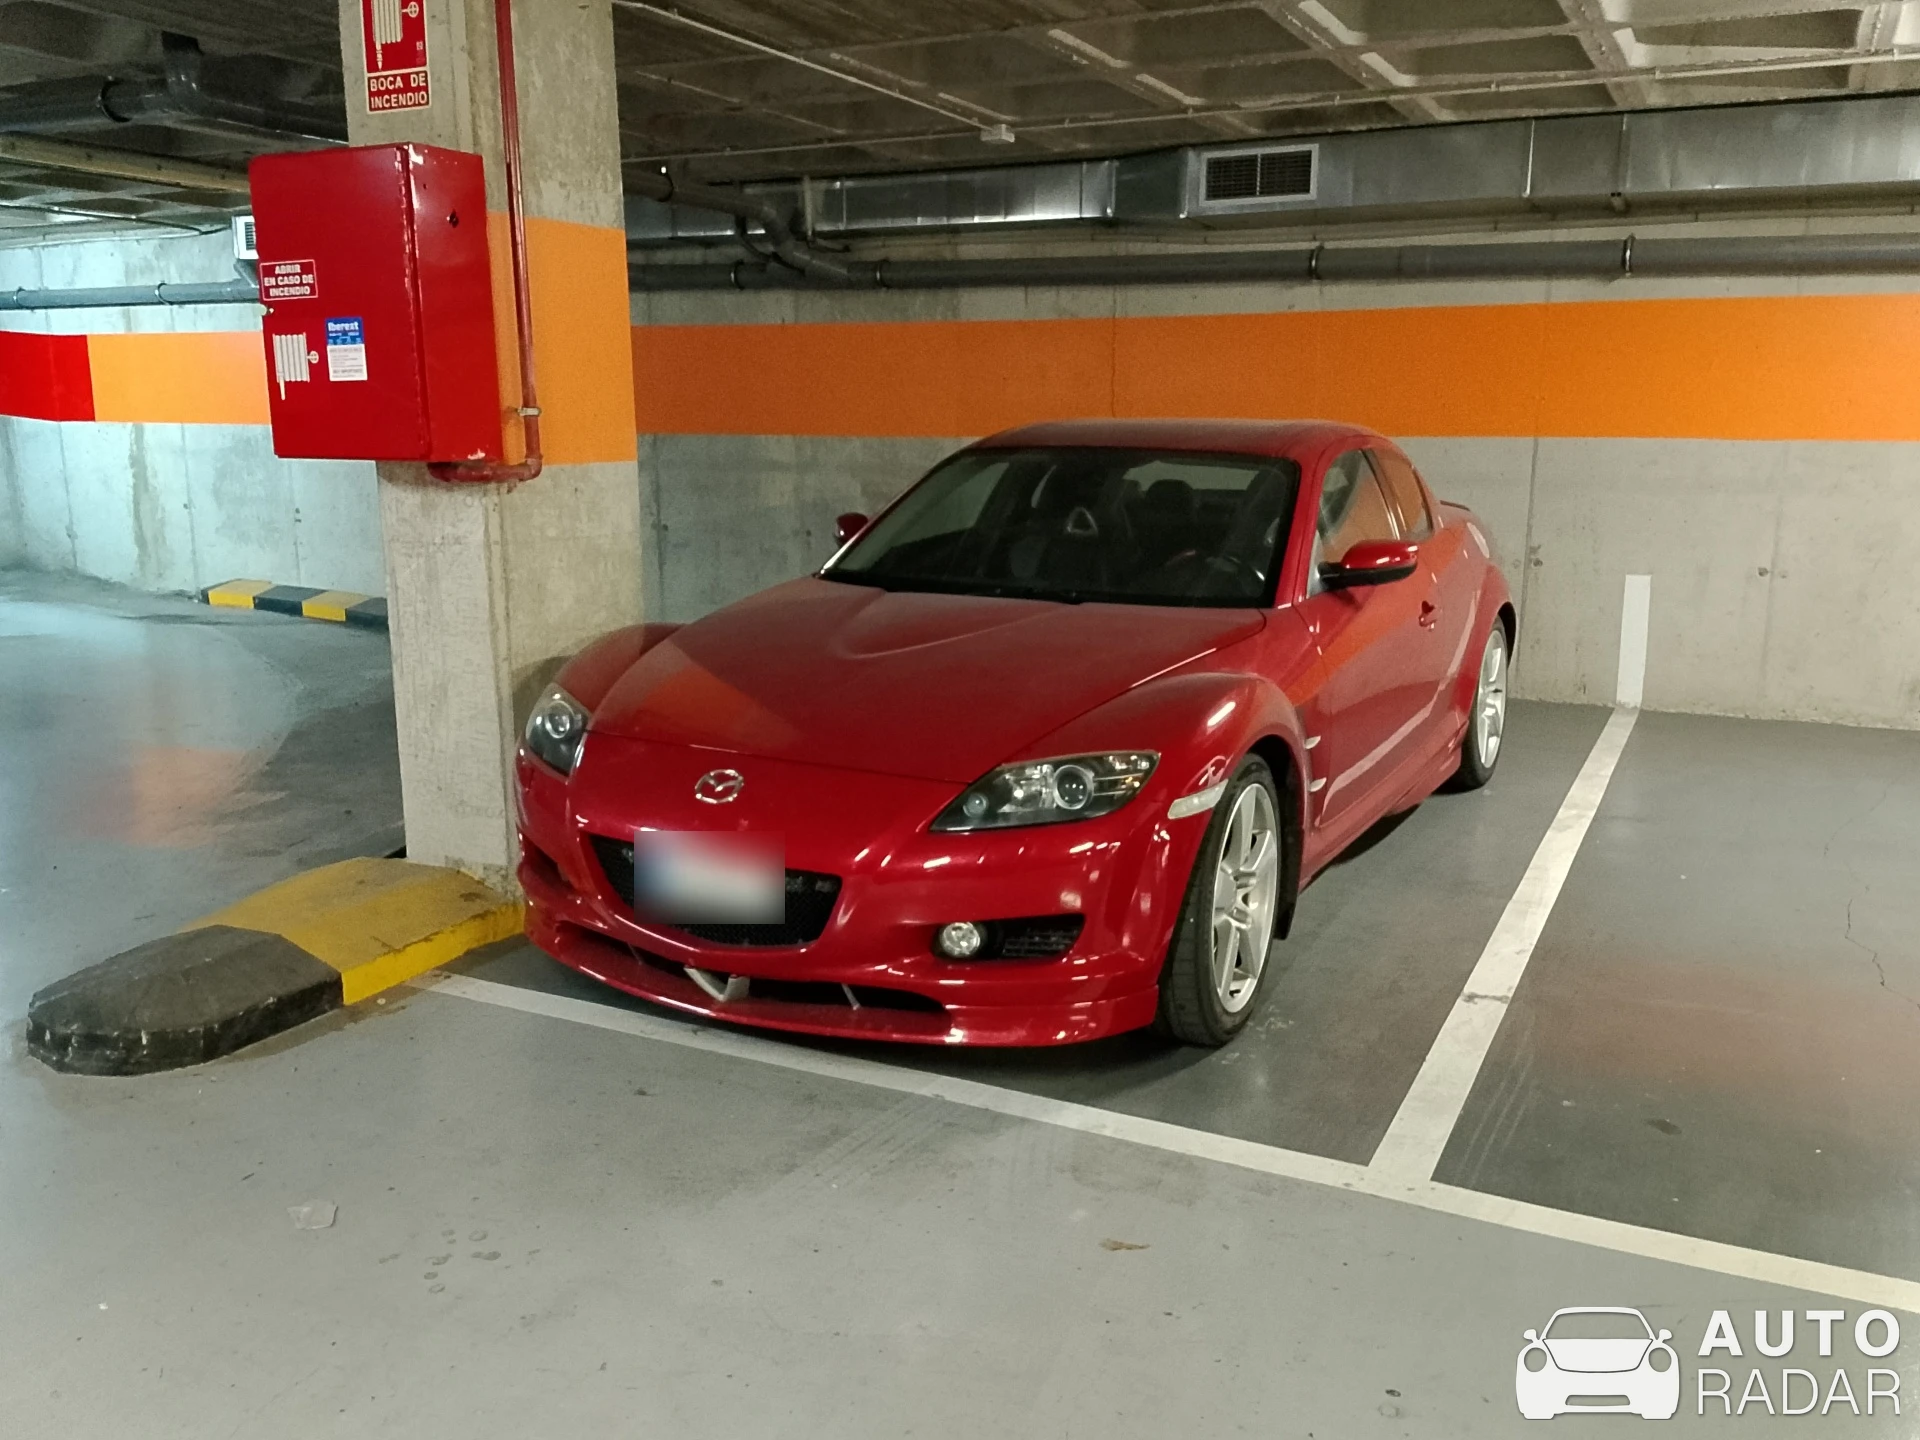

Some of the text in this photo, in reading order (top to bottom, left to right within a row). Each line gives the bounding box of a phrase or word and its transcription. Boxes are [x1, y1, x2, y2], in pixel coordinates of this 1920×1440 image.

[370, 73, 426, 92] BOCA DE
[370, 91, 428, 109] INCENDIO
[275, 264, 301, 275] ABRIR
[264, 274, 314, 286] EN CASO DE
[270, 286, 310, 297] INCENDIO
